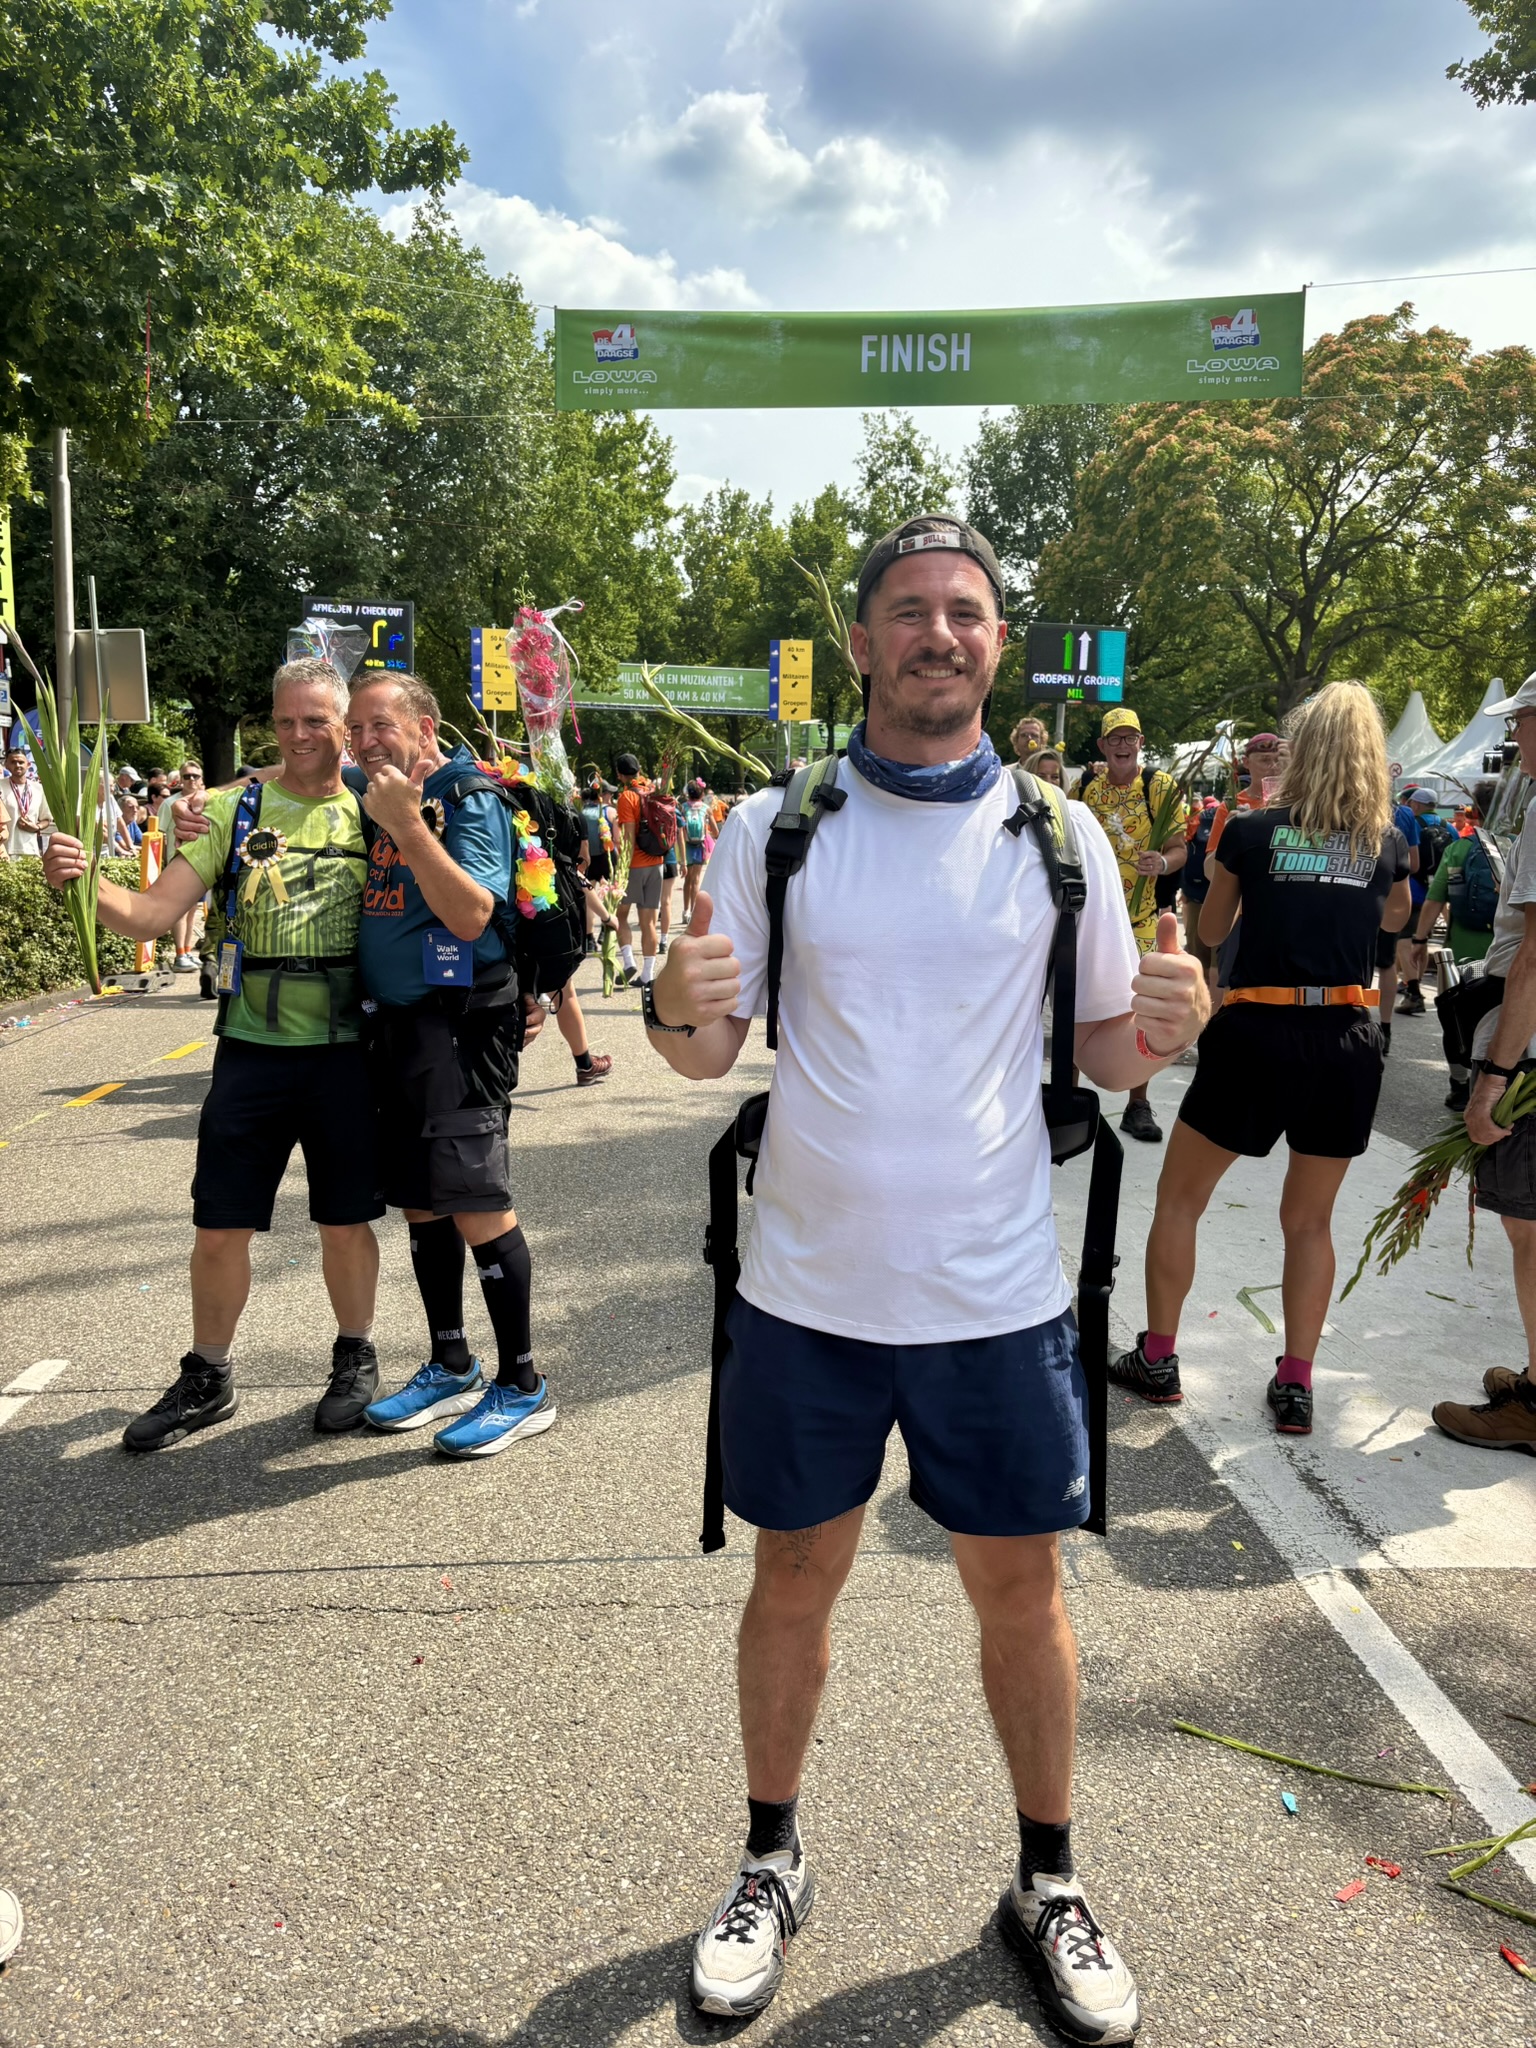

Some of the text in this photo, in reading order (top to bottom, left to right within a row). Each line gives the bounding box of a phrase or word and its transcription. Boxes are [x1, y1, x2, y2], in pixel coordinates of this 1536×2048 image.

[1214, 308, 1256, 336] DE 4
[597, 323, 636, 350] DE 4
[1214, 336, 1255, 345] DAAGSE
[597, 349, 635, 358] DAAGSE
[861, 332, 971, 373] FINISH
[1187, 356, 1279, 373] LOWA
[573, 370, 657, 383] LOWA
[1198, 375, 1270, 385] simply more...
[584, 387, 649, 396] simply more...
[923, 534, 947, 546] BULLS
[355, 606, 360, 616] /
[361, 606, 387, 616] CHECK
[387, 608, 404, 617] OUT
[485, 662, 512, 670] Militaire
[667, 674, 678, 684] EN
[680, 674, 734, 687] MUZIKANTEN
[1032, 673, 1121, 687] GROEPEN / GROUPS
[486, 689, 512, 697] Groepen
[624, 689, 633, 699] 50
[636, 689, 649, 700] KM
[677, 691, 690, 702] KM
[692, 692, 699, 702] &
[700, 692, 711, 702] 40
[713, 693, 726, 703] KM
[1067, 688, 1084, 698] MIL
[783, 700, 807, 708] Groepen
[252, 841, 267, 851] did
[1275, 852, 1374, 877] TOMOSHOP
[436, 945, 459, 953] Walk
